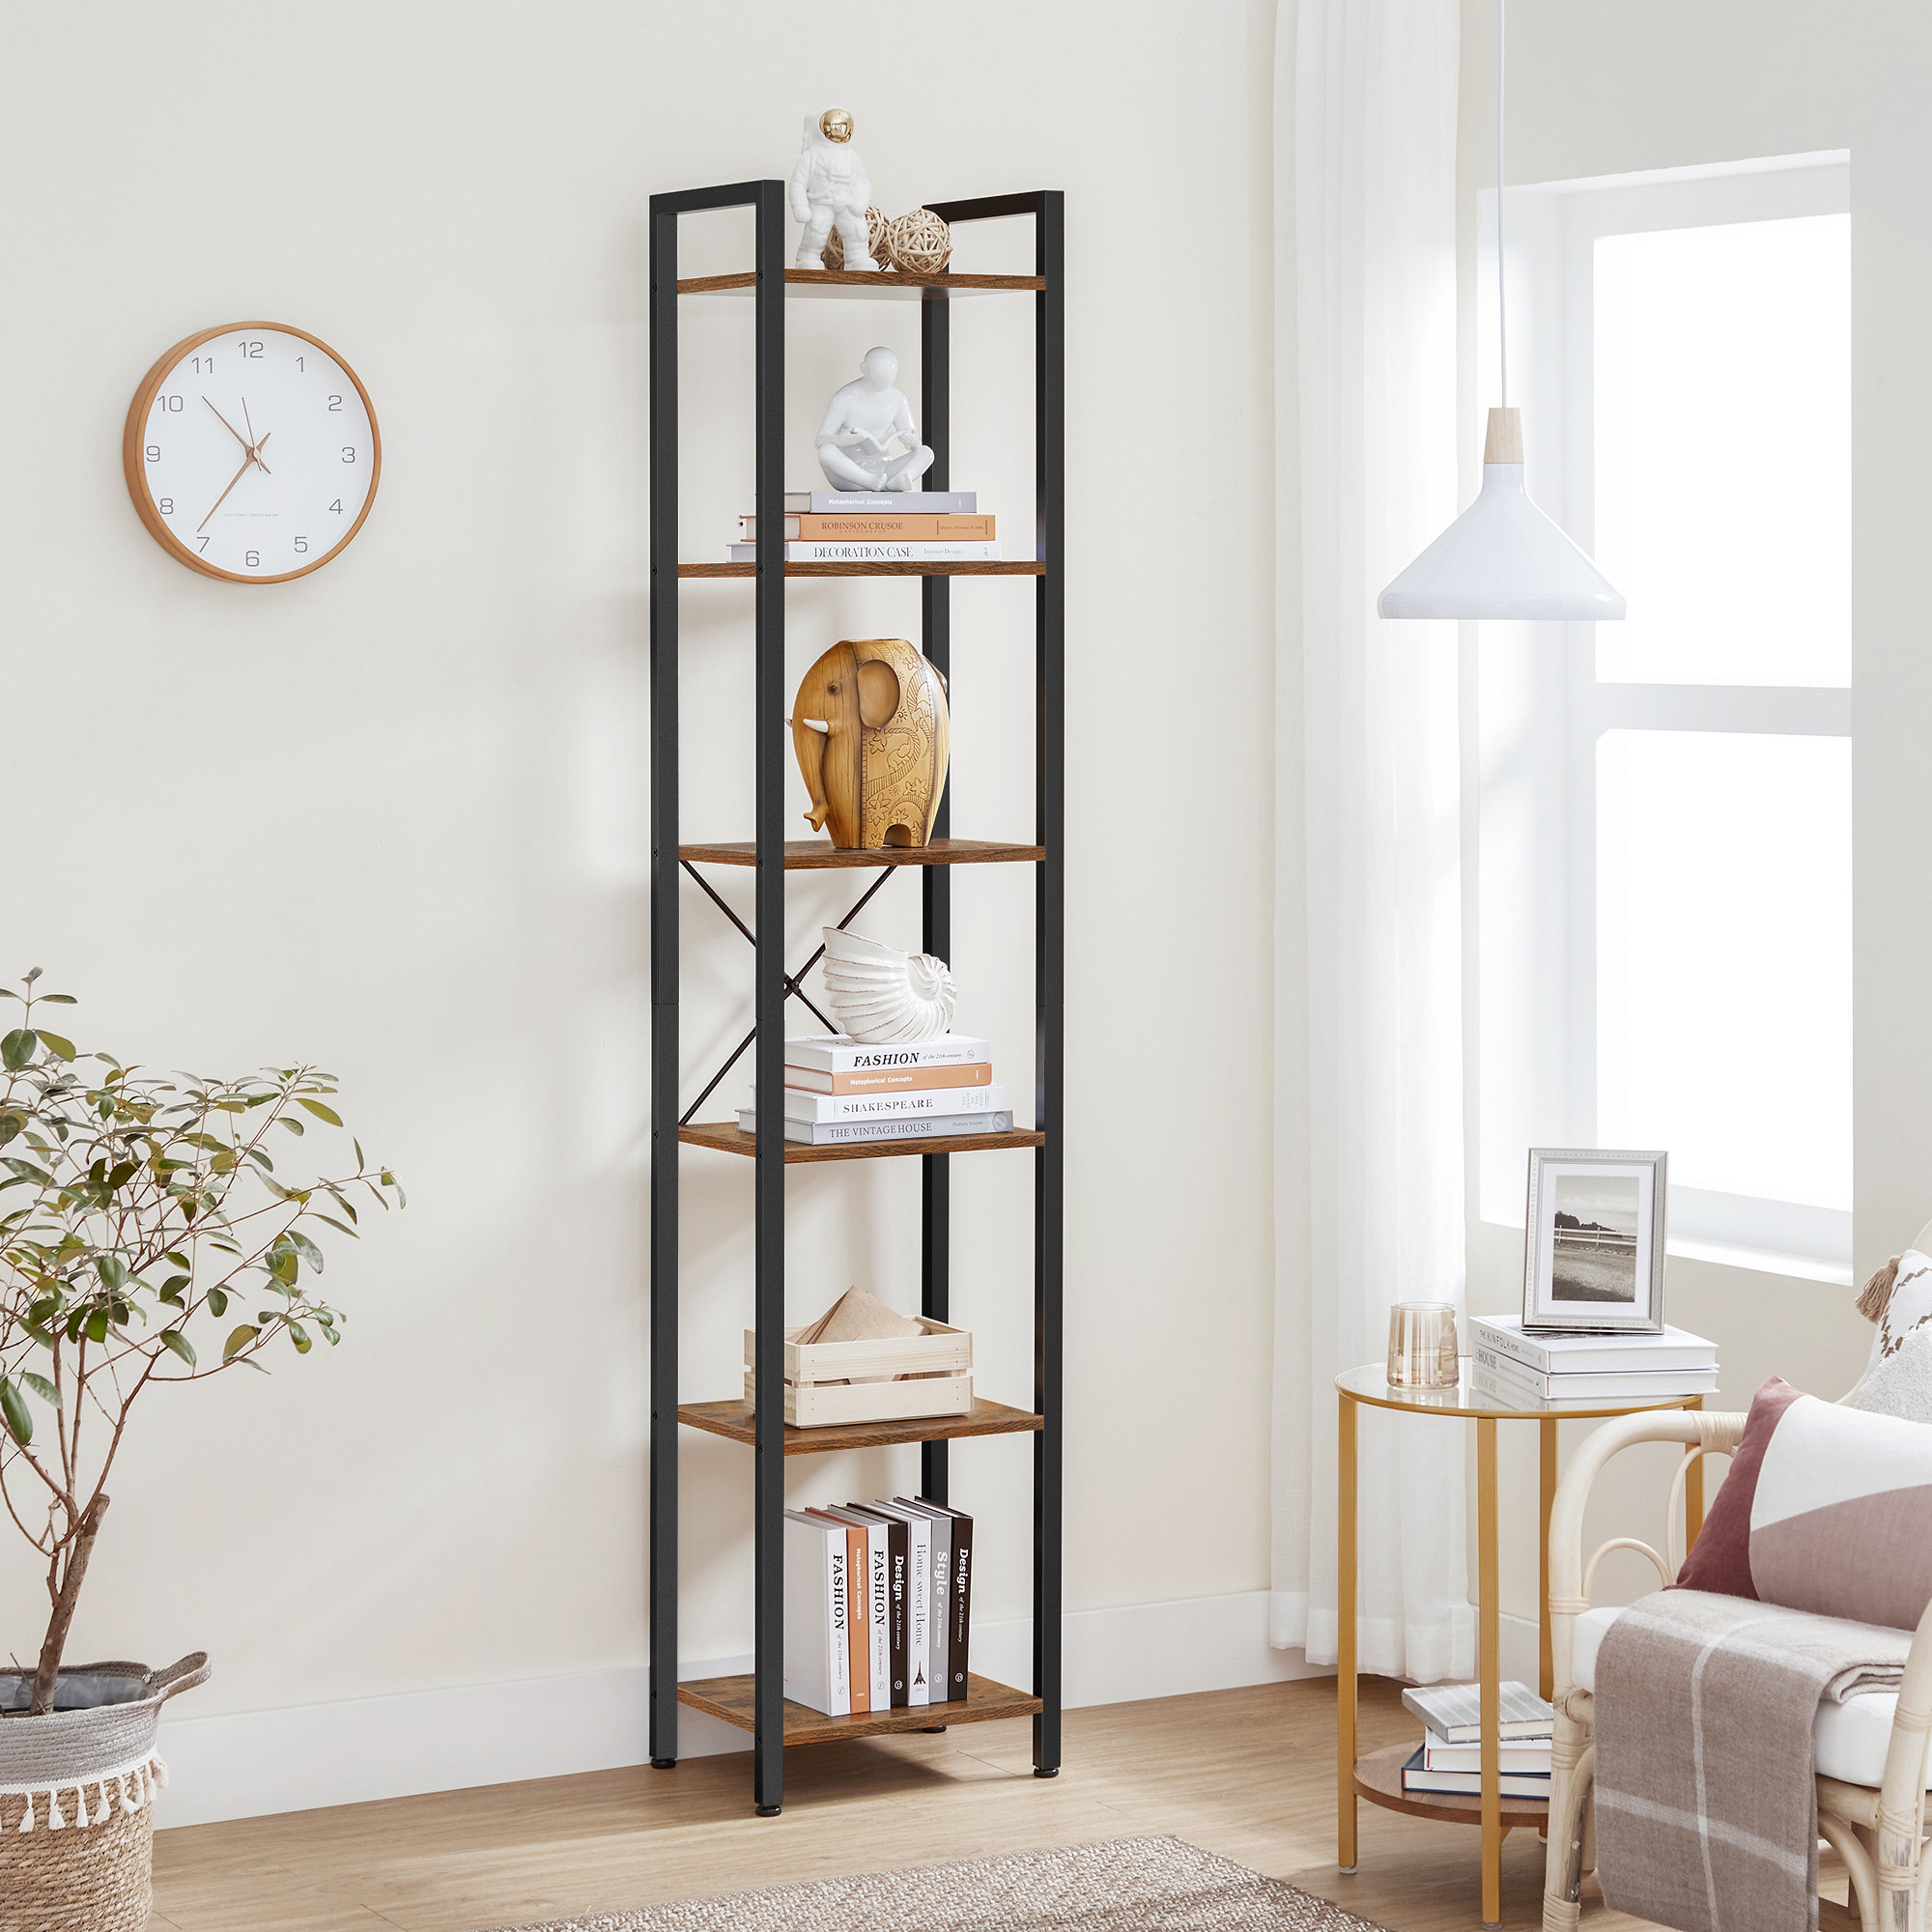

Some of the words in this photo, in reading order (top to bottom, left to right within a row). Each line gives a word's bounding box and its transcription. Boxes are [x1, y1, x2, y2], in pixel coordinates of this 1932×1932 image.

[238, 342, 264, 358] 12
[191, 357, 213, 374] 11
[296, 356, 304, 373] 1
[157, 395, 184, 412] 10
[328, 395, 343, 412] 2
[146, 445, 160, 462] 9
[342, 447, 355, 464] 3
[159, 498, 174, 515] 8
[328, 499, 344, 515] 4
[196, 536, 211, 554] 7
[294, 536, 308, 554] 5
[814, 547, 885, 557] DECORATION
[887, 547, 914, 557] CASE
[245, 551, 260, 567] 6
[853, 1052, 920, 1067] FASHION
[850, 1077, 886, 1086] Metaphorical
[842, 1098, 933, 1113] SHAKESPEARE
[830, 1128, 850, 1138] THE
[853, 1125, 896, 1136] VINTAGE
[897, 1122, 932, 1133] HOUSE
[1487, 1332, 1511, 1350] KINFOLK
[1478, 1349, 1496, 1370] HOUSE
[917, 1544, 926, 1577] Home
[893, 1555, 905, 1602] Design
[934, 1551, 948, 1596] Style
[956, 1548, 969, 1594] Design
[834, 1554, 844, 1630] FASHION
[874, 1550, 885, 1626] FASHION
[916, 1612, 925, 1646] Home
